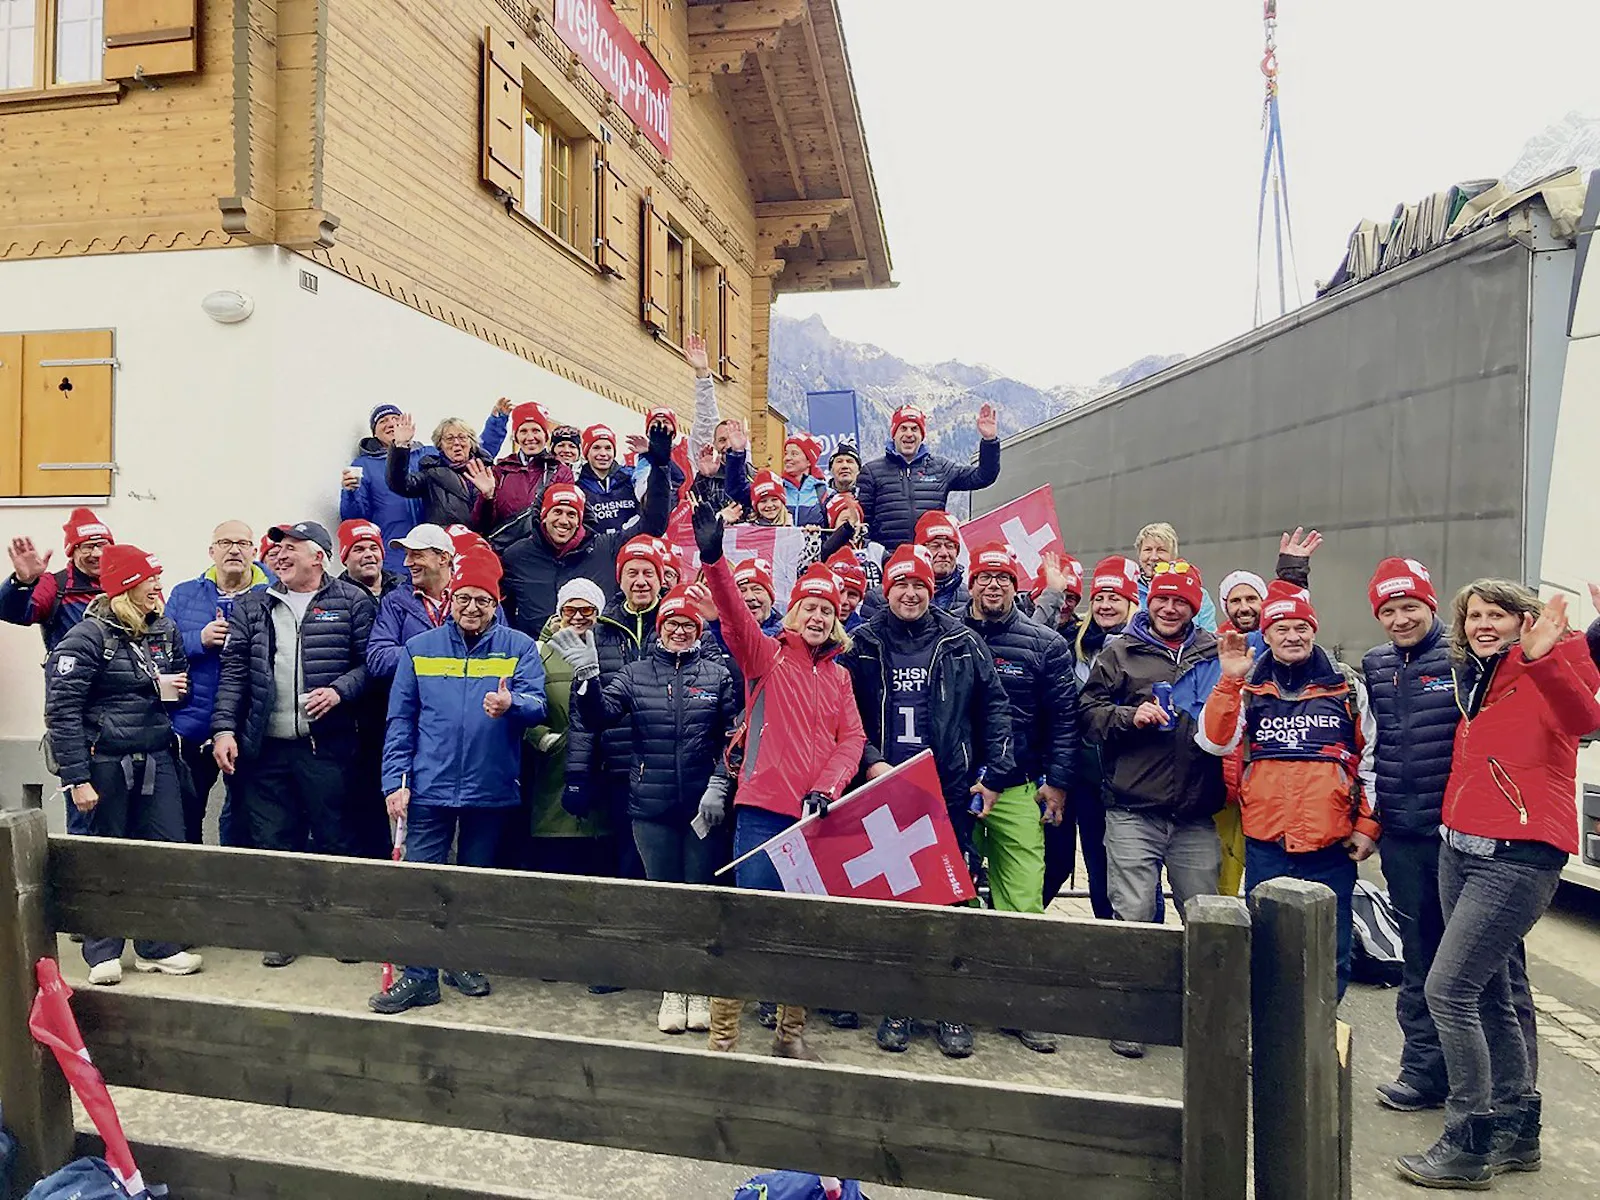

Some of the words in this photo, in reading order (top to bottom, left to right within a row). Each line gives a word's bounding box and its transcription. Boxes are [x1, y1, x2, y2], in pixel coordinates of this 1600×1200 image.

[592, 500, 635, 511] CHSNER
[595, 509, 619, 519] ORT
[897, 707, 921, 743] 1
[1260, 715, 1340, 730] OCHSNER
[1256, 728, 1309, 743] SPORT
